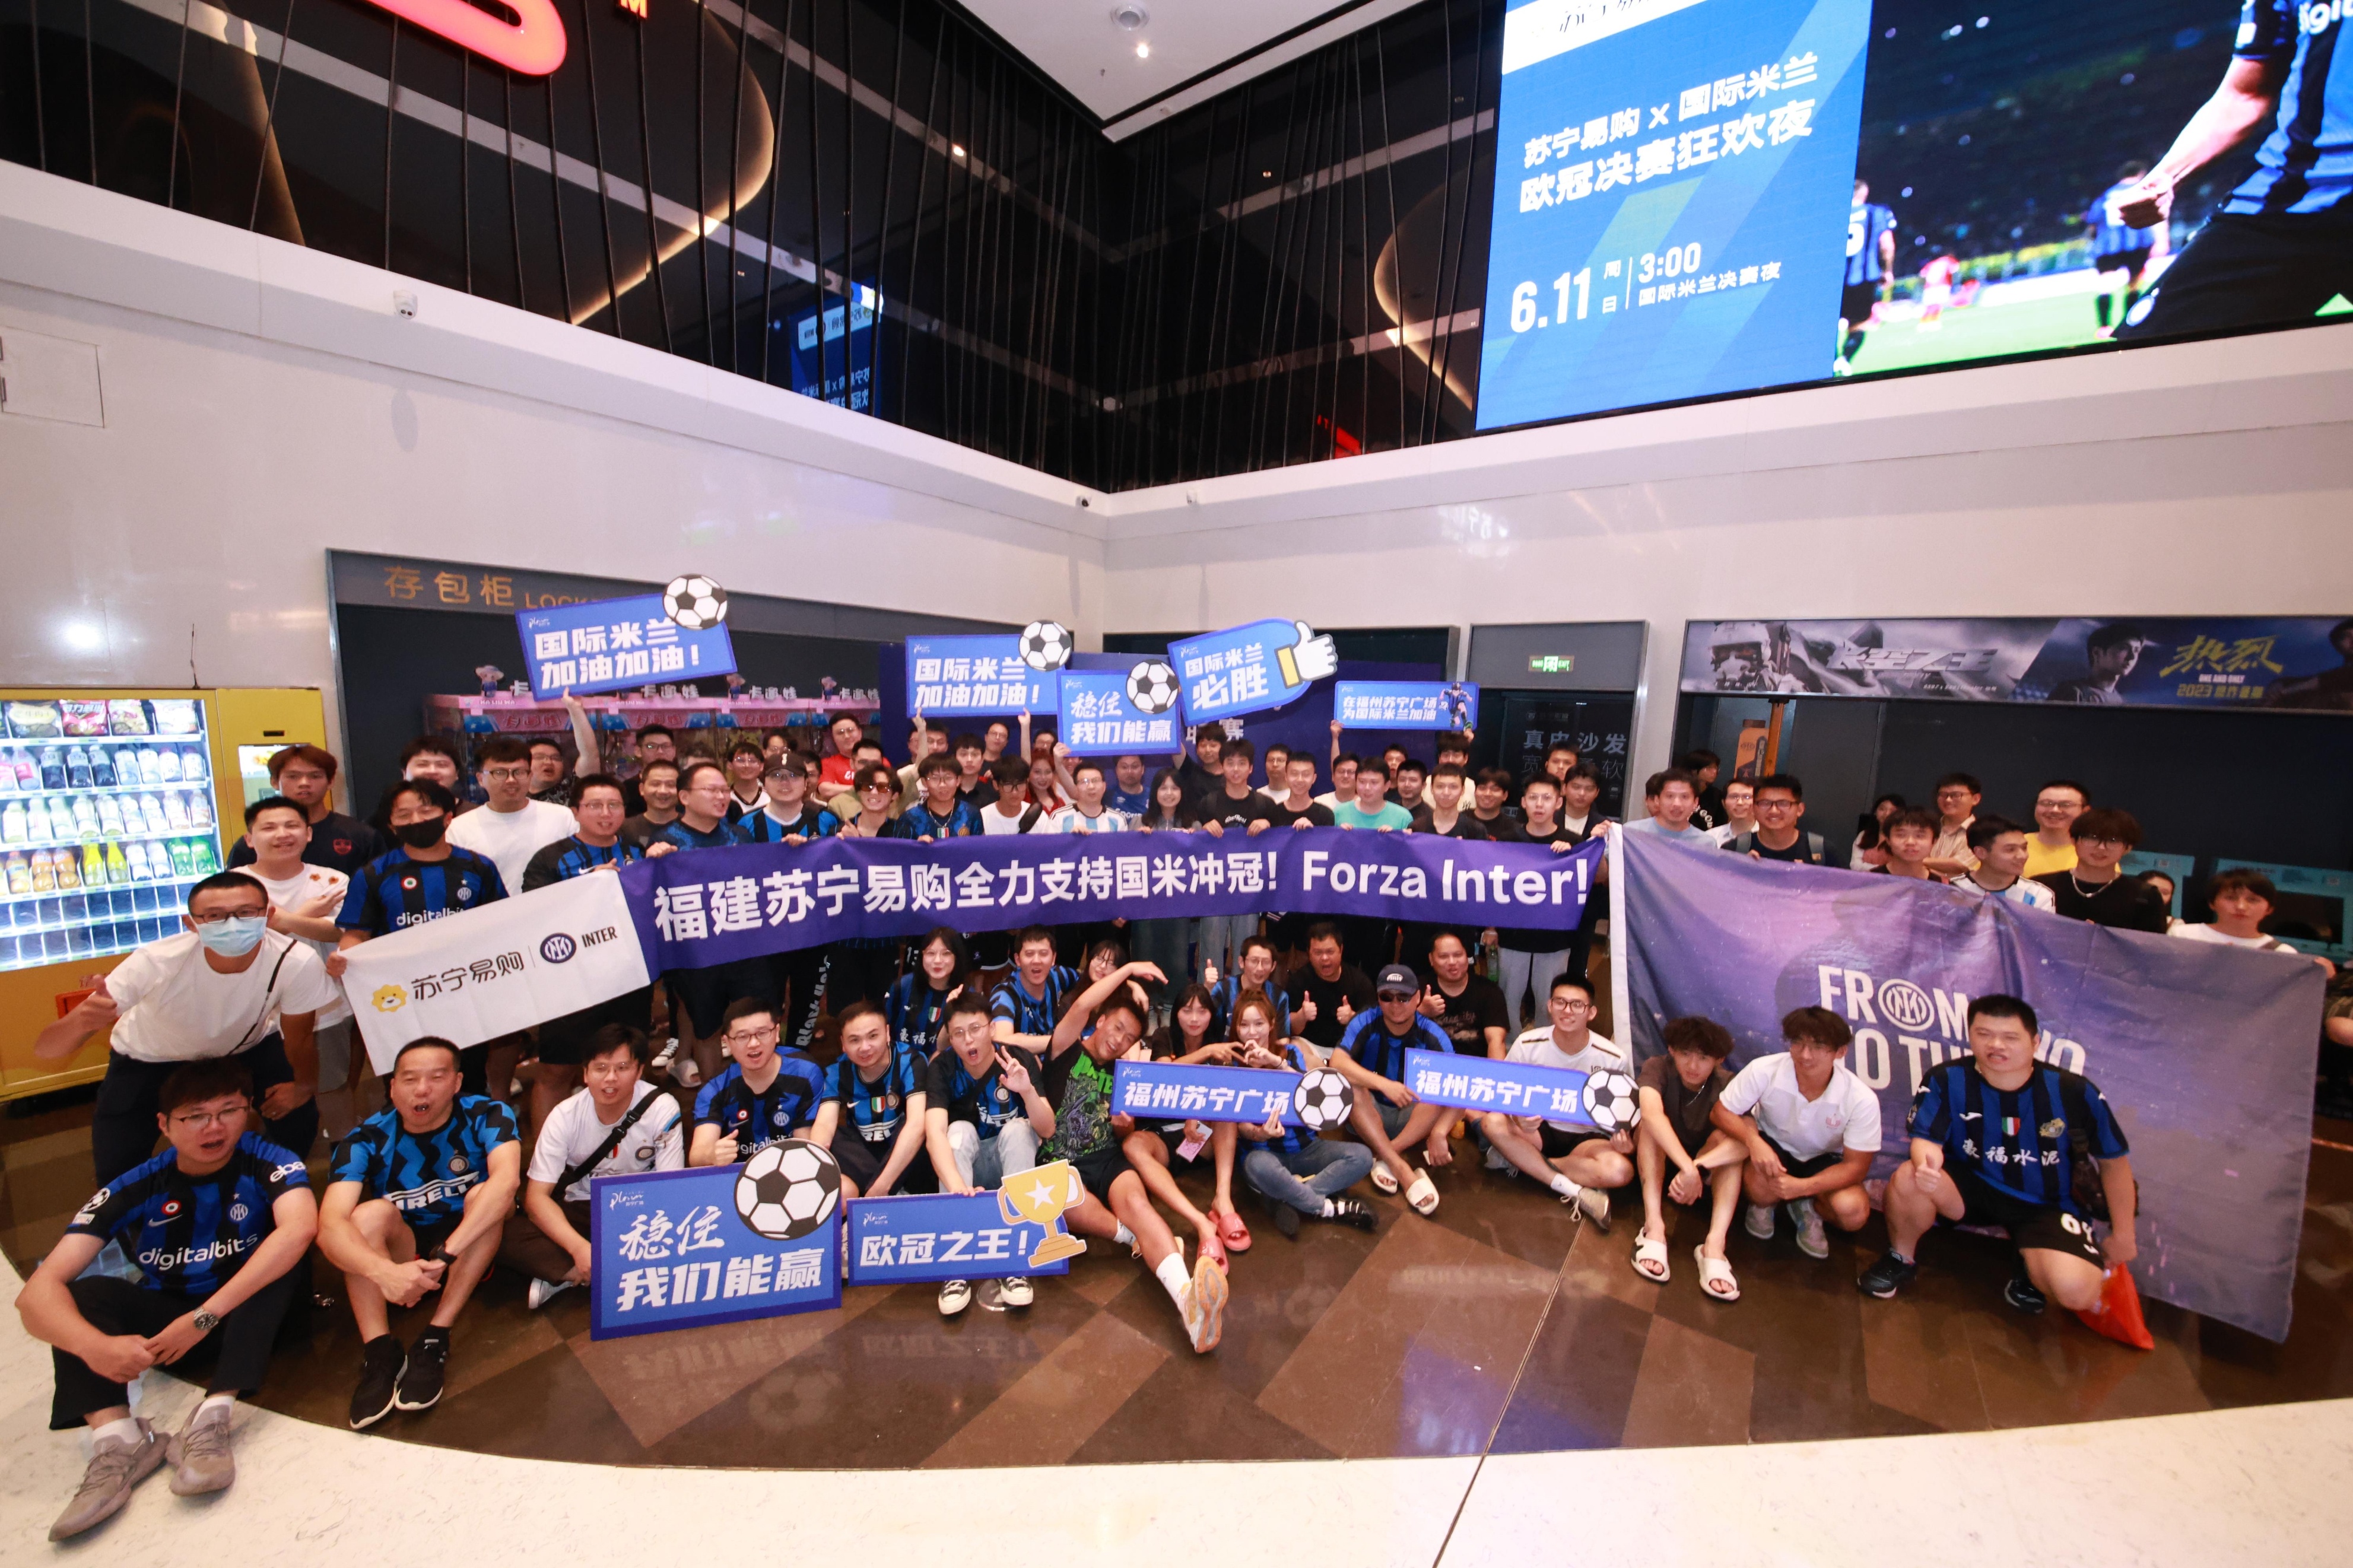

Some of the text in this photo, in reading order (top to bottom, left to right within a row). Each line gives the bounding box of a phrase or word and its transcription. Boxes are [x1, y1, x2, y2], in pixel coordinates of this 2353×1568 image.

[1524, 107, 1640, 168] 苏宁易购
[1678, 52, 1818, 120] 国际米兰
[1519, 98, 1816, 214] 欧冠决赛狂欢夜
[1638, 242, 1702, 284] 3:00
[1638, 260, 1782, 307] 国际米兰决赛夜
[1509, 267, 1592, 333] 6.11
[383, 565, 515, 608] 存包柜
[534, 616, 679, 660] 国际米兰
[2159, 634, 2284, 678] 热烈
[541, 644, 700, 690] 加油加油!
[914, 657, 1026, 682] 国际米兰
[1185, 643, 1265, 679] 国际米兰
[914, 683, 1040, 708] 加油加油!
[1070, 690, 1123, 718] 稳住
[1192, 663, 1269, 711] 必胜
[1343, 695, 1438, 709] 在福州苏宁广场
[2177, 683, 2212, 698] 2023
[1070, 719, 1173, 745] 我们能赢
[1342, 707, 1437, 721] 为国际米兰加油
[1523, 729, 1627, 755] 真皮沙发
[654, 850, 1589, 942] 福建苏宁易购全力支持国米冲冠! Forza Inter!
[412, 926, 618, 1001] 苏宁易购 INTER
[1124, 1081, 1291, 1116] 福州苏宁广场
[1415, 1069, 1579, 1114] 福州苏宁广场
[270, 1161, 306, 1183] eba
[139, 1233, 258, 1271] digitalbits
[619, 1205, 725, 1261] 稳住
[859, 1228, 1028, 1267] 欧冠之王!
[617, 1248, 825, 1312] 我们能赢
